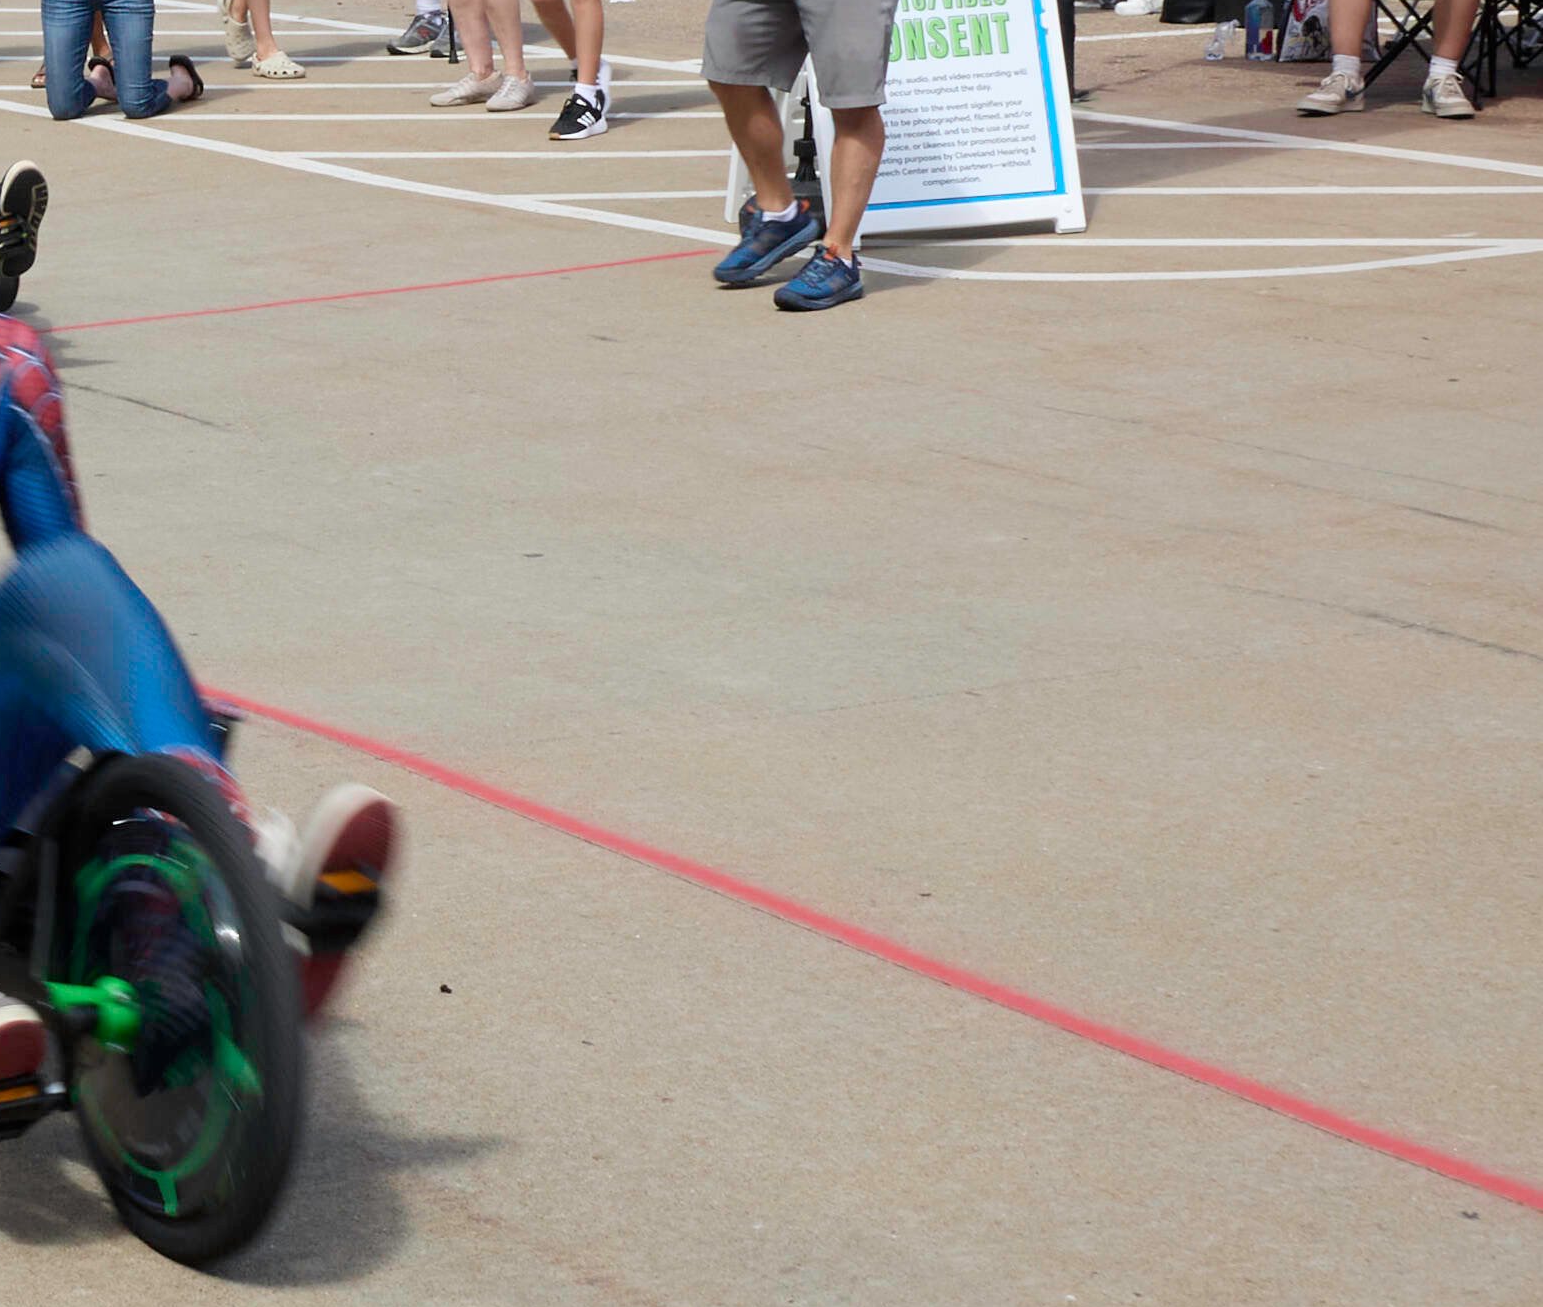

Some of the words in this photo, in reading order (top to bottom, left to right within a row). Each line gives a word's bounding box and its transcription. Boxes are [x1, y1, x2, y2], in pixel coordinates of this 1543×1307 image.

[888, 12, 1010, 62] ONSENT
[932, 73, 947, 82] and
[948, 72, 971, 82] video
[972, 69, 1012, 80] recording
[1013, 67, 1028, 76] will
[889, 89, 912, 97] occur
[914, 86, 959, 97] throughout
[961, 84, 975, 93] the
[883, 106, 919, 115] entrance
[920, 105, 930, 113] to
[931, 103, 945, 112] the
[946, 102, 969, 112] event
[970, 100, 1004, 111] signifies
[1005, 99, 1023, 109] your
[901, 119, 911, 127] be
[1004, 110, 1033, 119] and/or
[944, 127, 960, 136] and
[961, 126, 970, 134] to
[971, 125, 986, 134] the
[986, 124, 1001, 132] use
[1002, 123, 1011, 131] of
[1012, 122, 1030, 132] your
[922, 140, 957, 149] likeness
[957, 139, 970, 148] for
[970, 136, 1019, 148] promotional
[1021, 134, 1036, 143] and
[904, 154, 944, 165] purposes
[943, 153, 954, 161] by
[955, 149, 996, 159] Cleveland
[997, 147, 1030, 157] Hearing
[901, 167, 929, 176] Center
[930, 165, 947, 174] and
[947, 164, 958, 172] its
